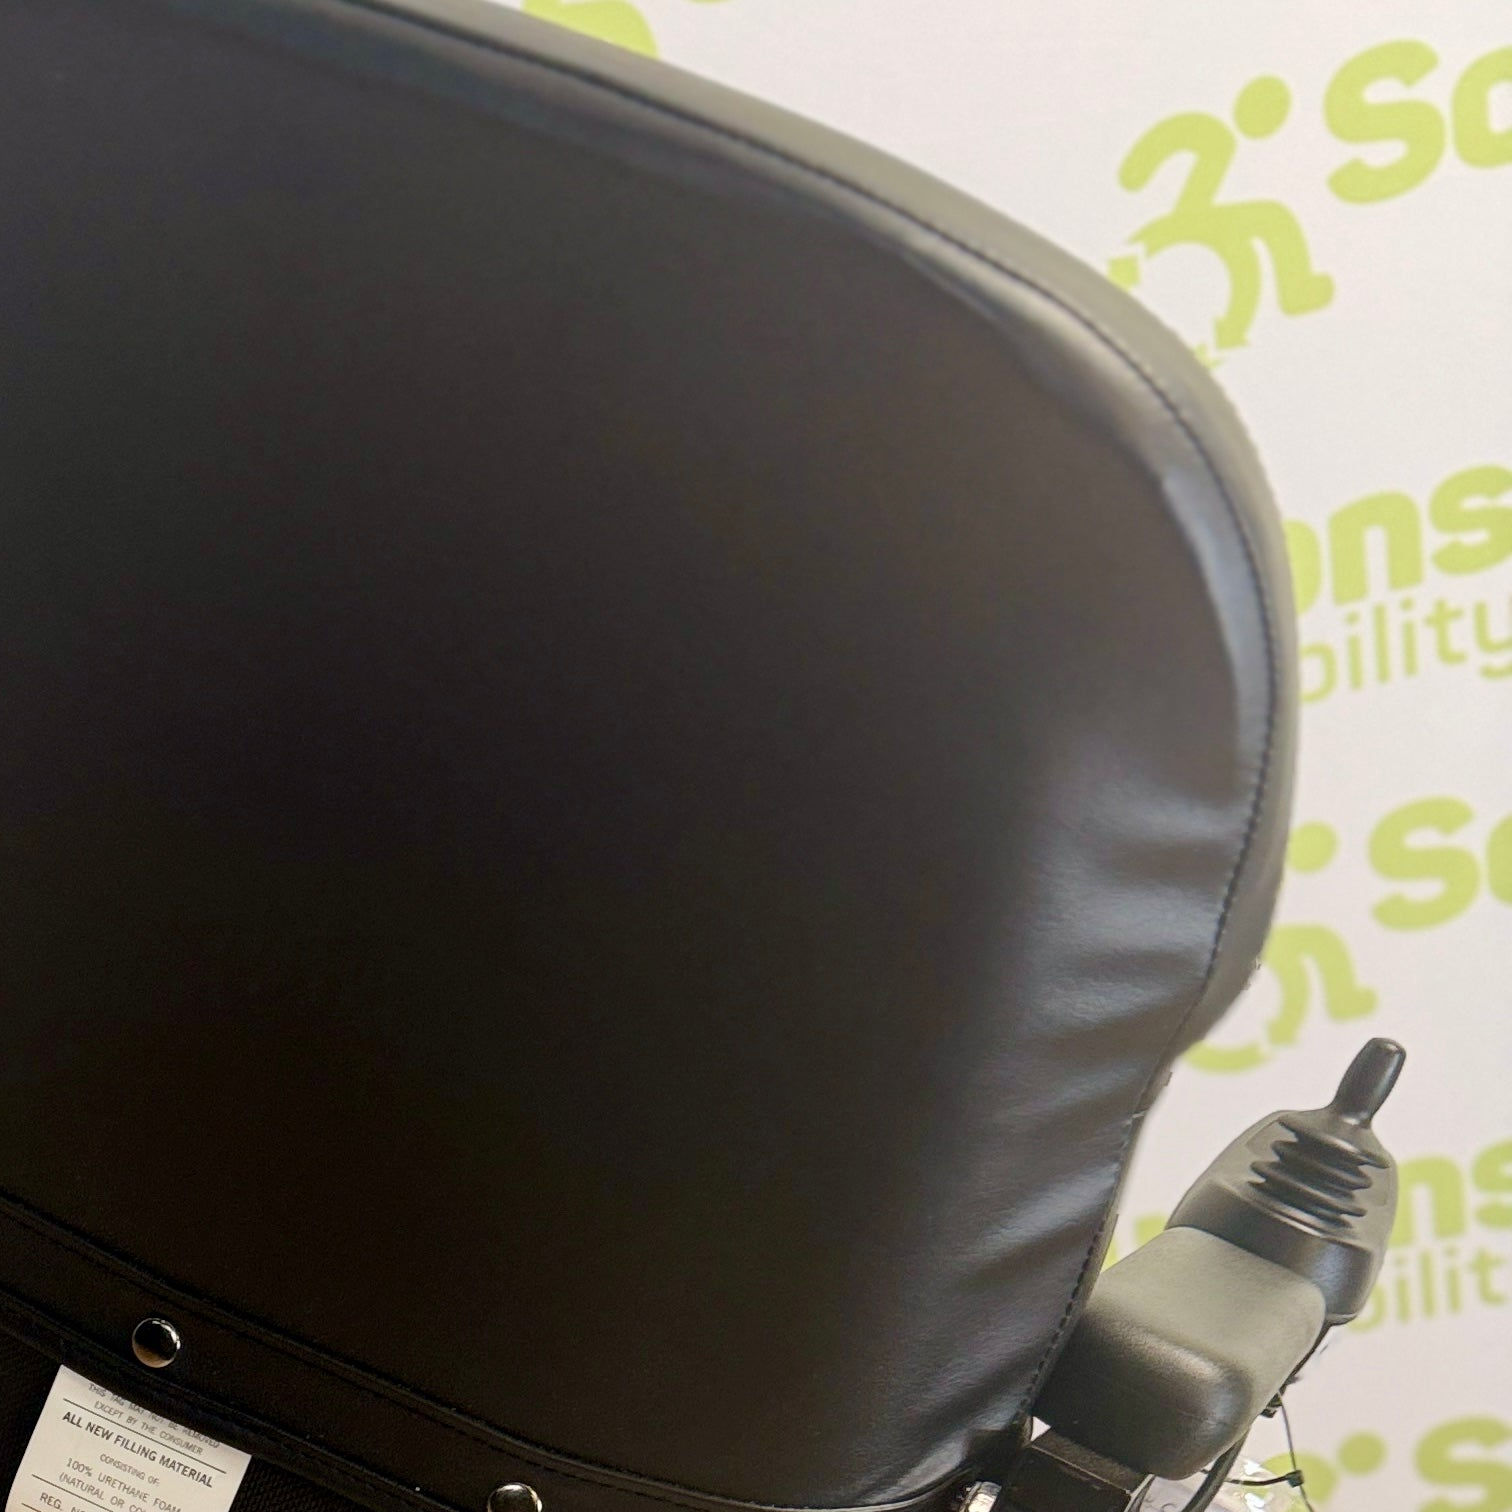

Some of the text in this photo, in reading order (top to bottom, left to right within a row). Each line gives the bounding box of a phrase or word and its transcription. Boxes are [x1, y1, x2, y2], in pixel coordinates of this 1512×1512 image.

[94, 1400, 204, 1455] EXCEPT BY THE CONSUMER
[62, 1410, 213, 1488] ALL NEW FILLING MATERIAL
[99, 1453, 145, 1480] CONSISTING
[39, 1491, 63, 1511] REG.
[59, 1471, 104, 1501] (NATURAL
[110, 1495, 125, 1510] OR
[65, 1457, 93, 1477] 100%
[98, 1471, 149, 1503] URETHANE
